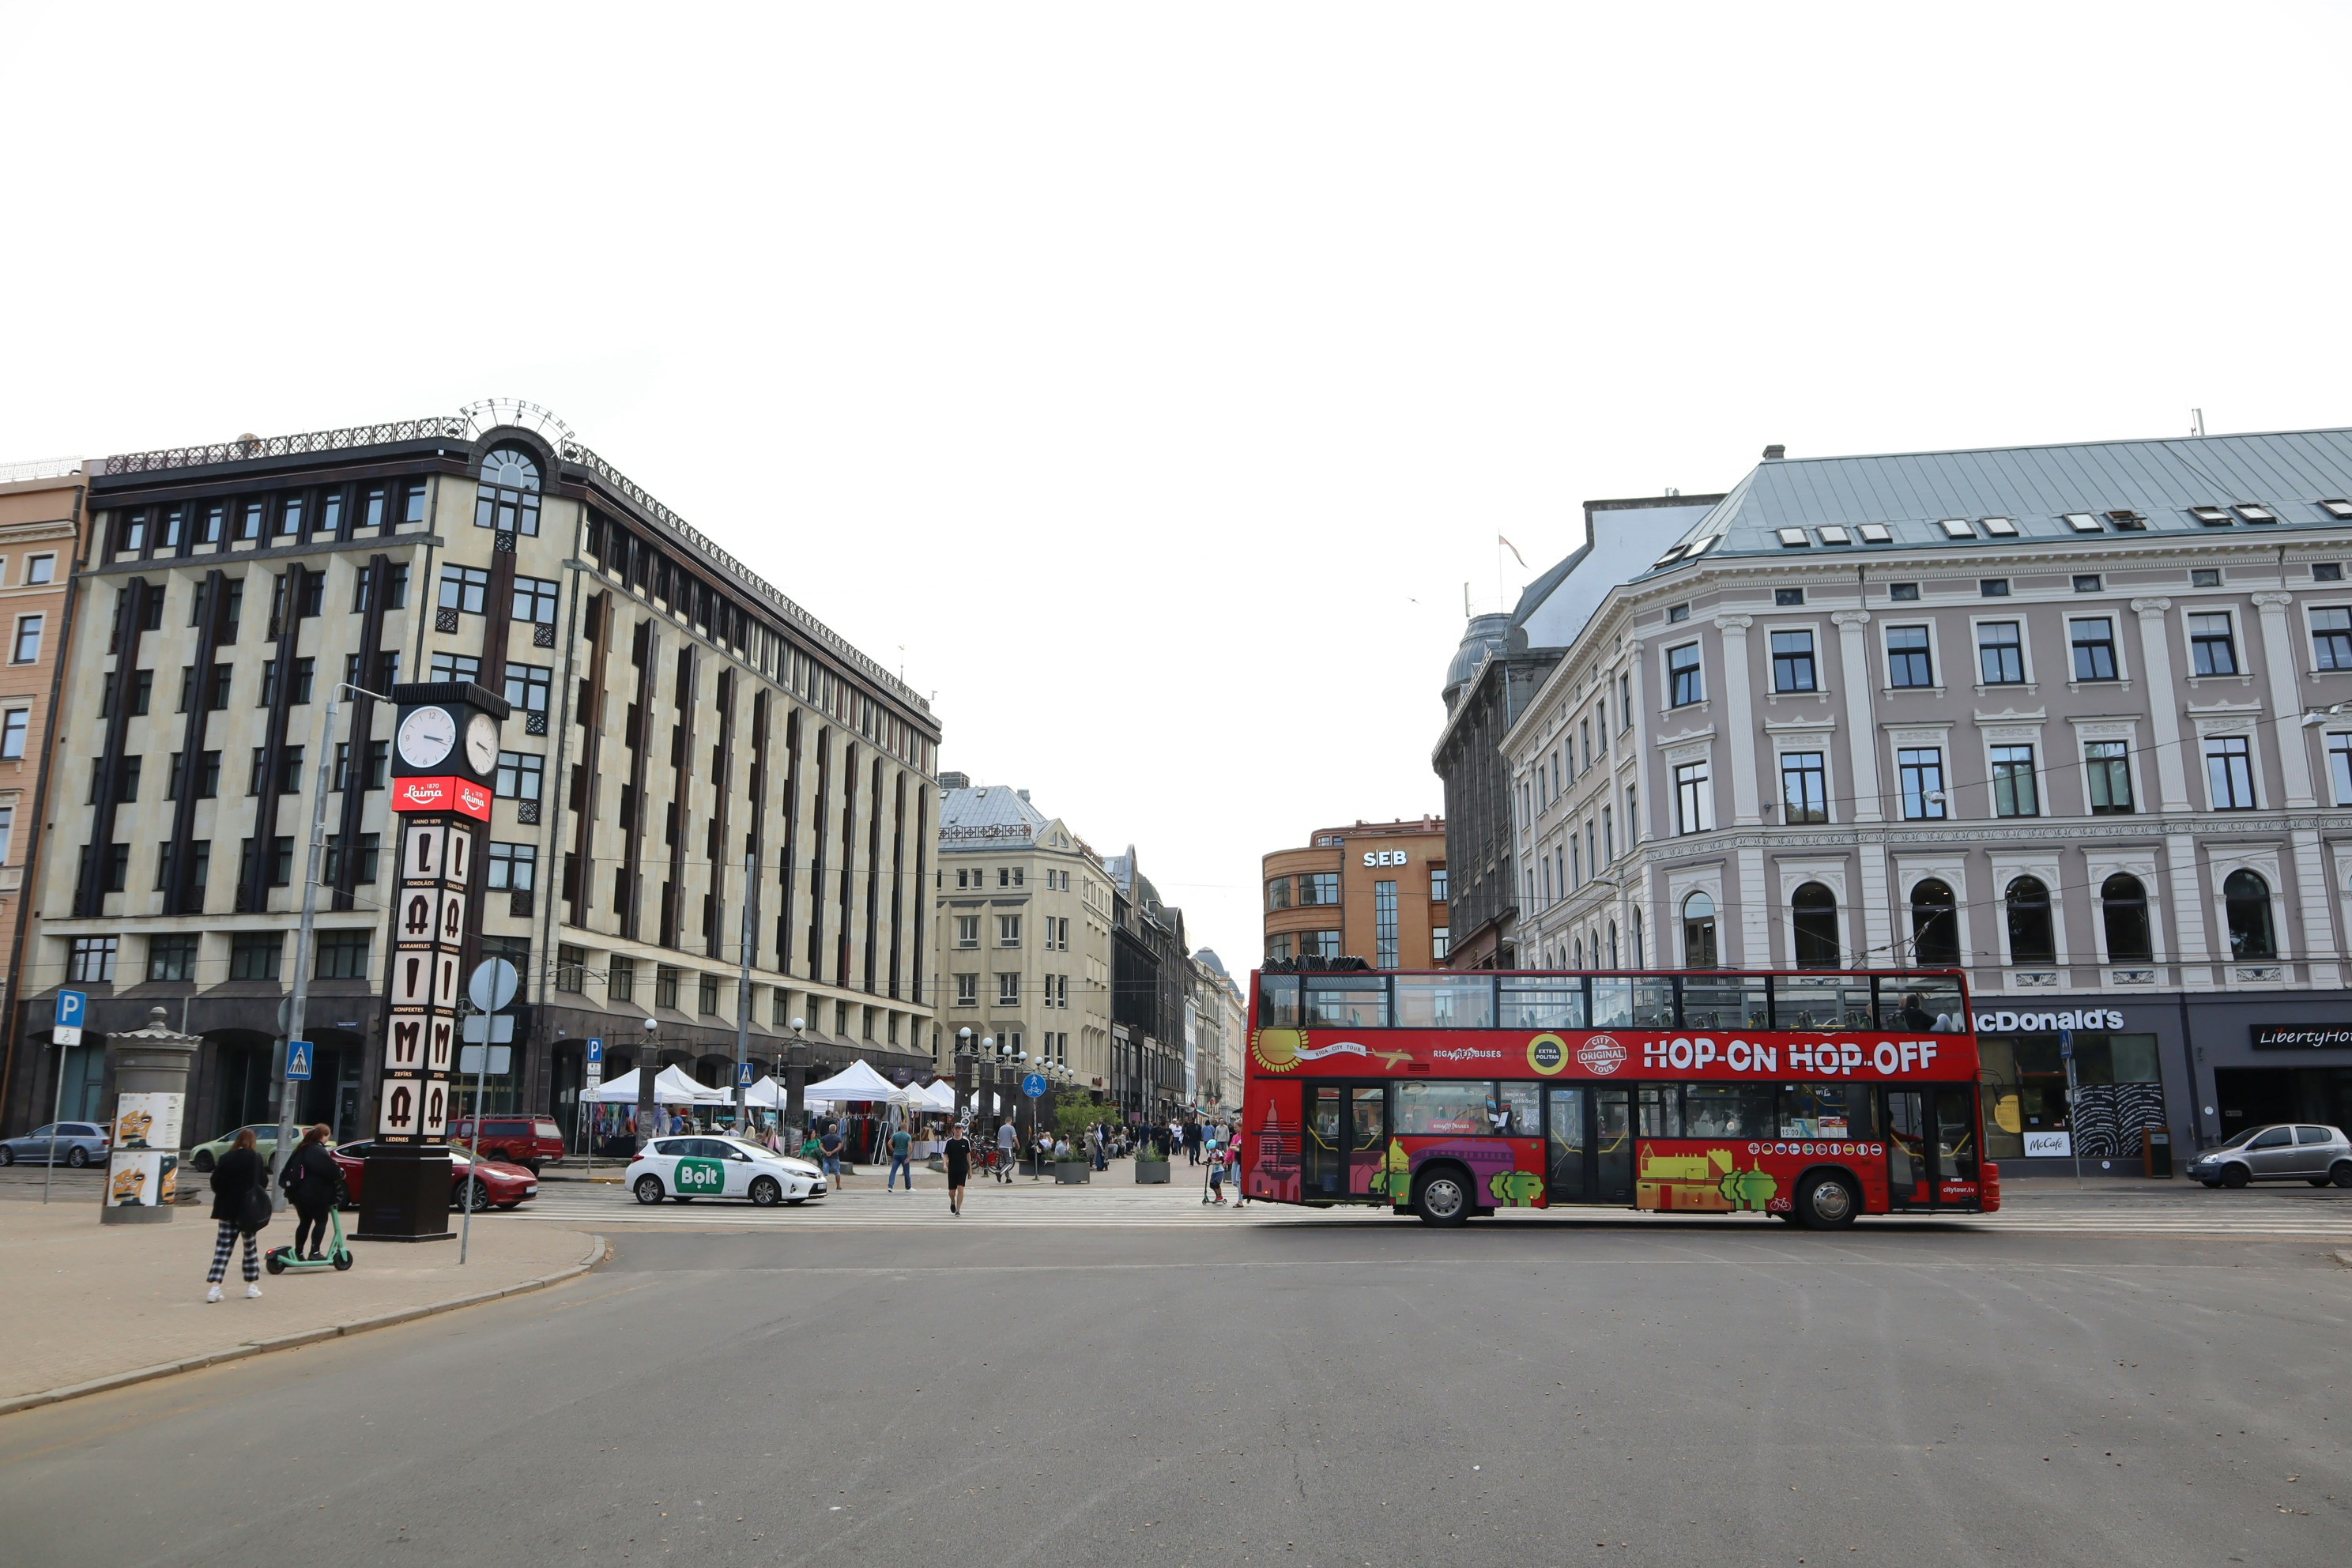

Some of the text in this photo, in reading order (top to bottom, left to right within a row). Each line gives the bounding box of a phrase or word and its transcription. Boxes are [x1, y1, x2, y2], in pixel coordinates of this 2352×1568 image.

[403, 785, 443, 804] Laima
[461, 788, 484, 811] Laima
[1363, 850, 1407, 868] SEB
[62, 995, 79, 1022] P
[590, 1040, 599, 1059] P
[1347, 1044, 1361, 1053] TOUR
[1592, 1037, 1610, 1046] CITY
[1581, 1050, 1624, 1061] ORIGINAL
[1644, 1038, 1938, 1076] HOP-ON HOP-OFF
[1594, 1065, 1614, 1073] TOUR
[2030, 1137, 2063, 1151] McCafé
[681, 1166, 717, 1189] Bolt
